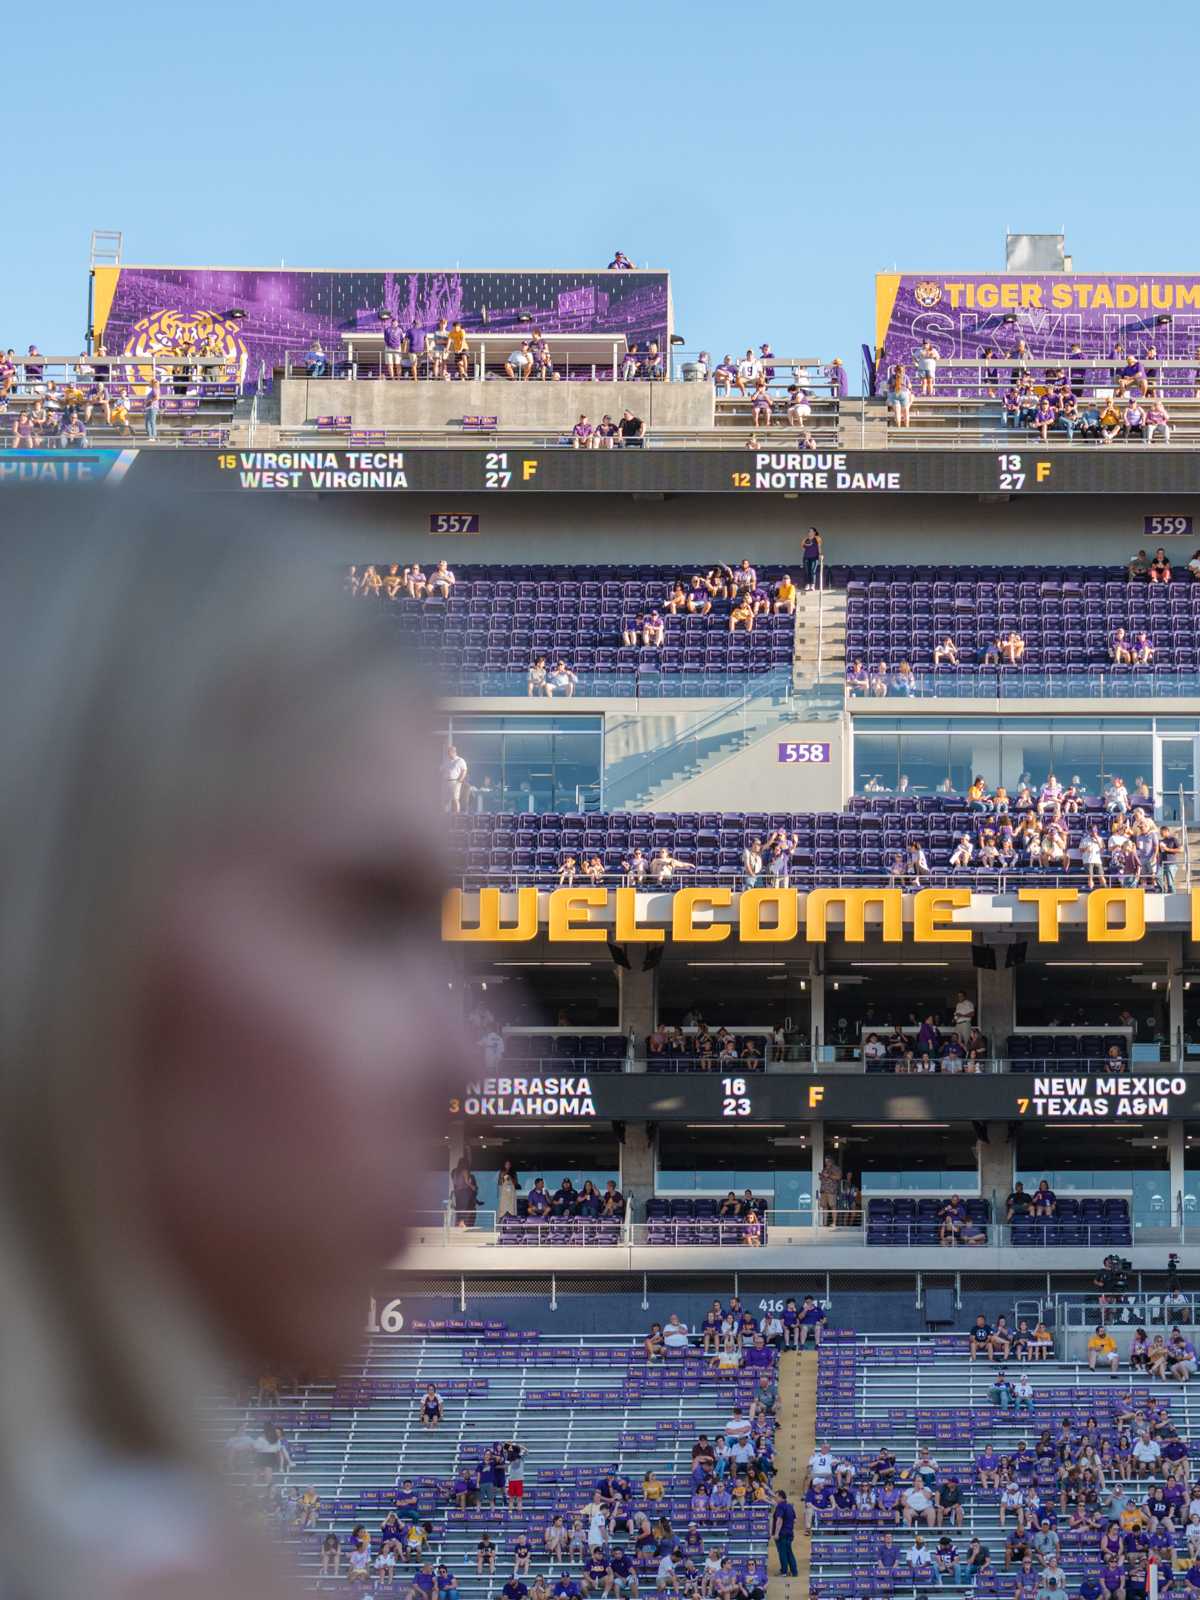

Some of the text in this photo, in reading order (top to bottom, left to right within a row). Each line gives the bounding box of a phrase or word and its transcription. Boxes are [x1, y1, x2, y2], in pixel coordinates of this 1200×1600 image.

[945, 284, 1042, 308] TIGER
[218, 453, 404, 470] 15 VIRGINIA TECH
[486, 453, 508, 470] 21
[756, 454, 847, 470] PURDUE
[998, 455, 1021, 471] 13
[523, 461, 538, 480] F
[1036, 462, 1051, 482] F
[240, 472, 408, 488] WEST VIRGINIA
[486, 472, 511, 488] 27
[732, 473, 901, 489] 12 NOTRE DAME
[999, 473, 1026, 490] 27
[437, 516, 473, 532] 557
[1152, 518, 1187, 534] 559
[786, 744, 823, 762] 558
[442, 888, 972, 941] WELCOME
[1019, 888, 1146, 942] TO
[467, 1078, 592, 1095] NEBRASKA
[722, 1078, 747, 1095] 16
[1034, 1078, 1187, 1095] NEW MEXICO
[809, 1087, 824, 1107] F
[449, 1098, 596, 1115] 3 OKLAHOMA
[723, 1098, 751, 1115] 23
[1017, 1098, 1169, 1115] 7 TEXAS A&M
[759, 1299, 784, 1312] 416
